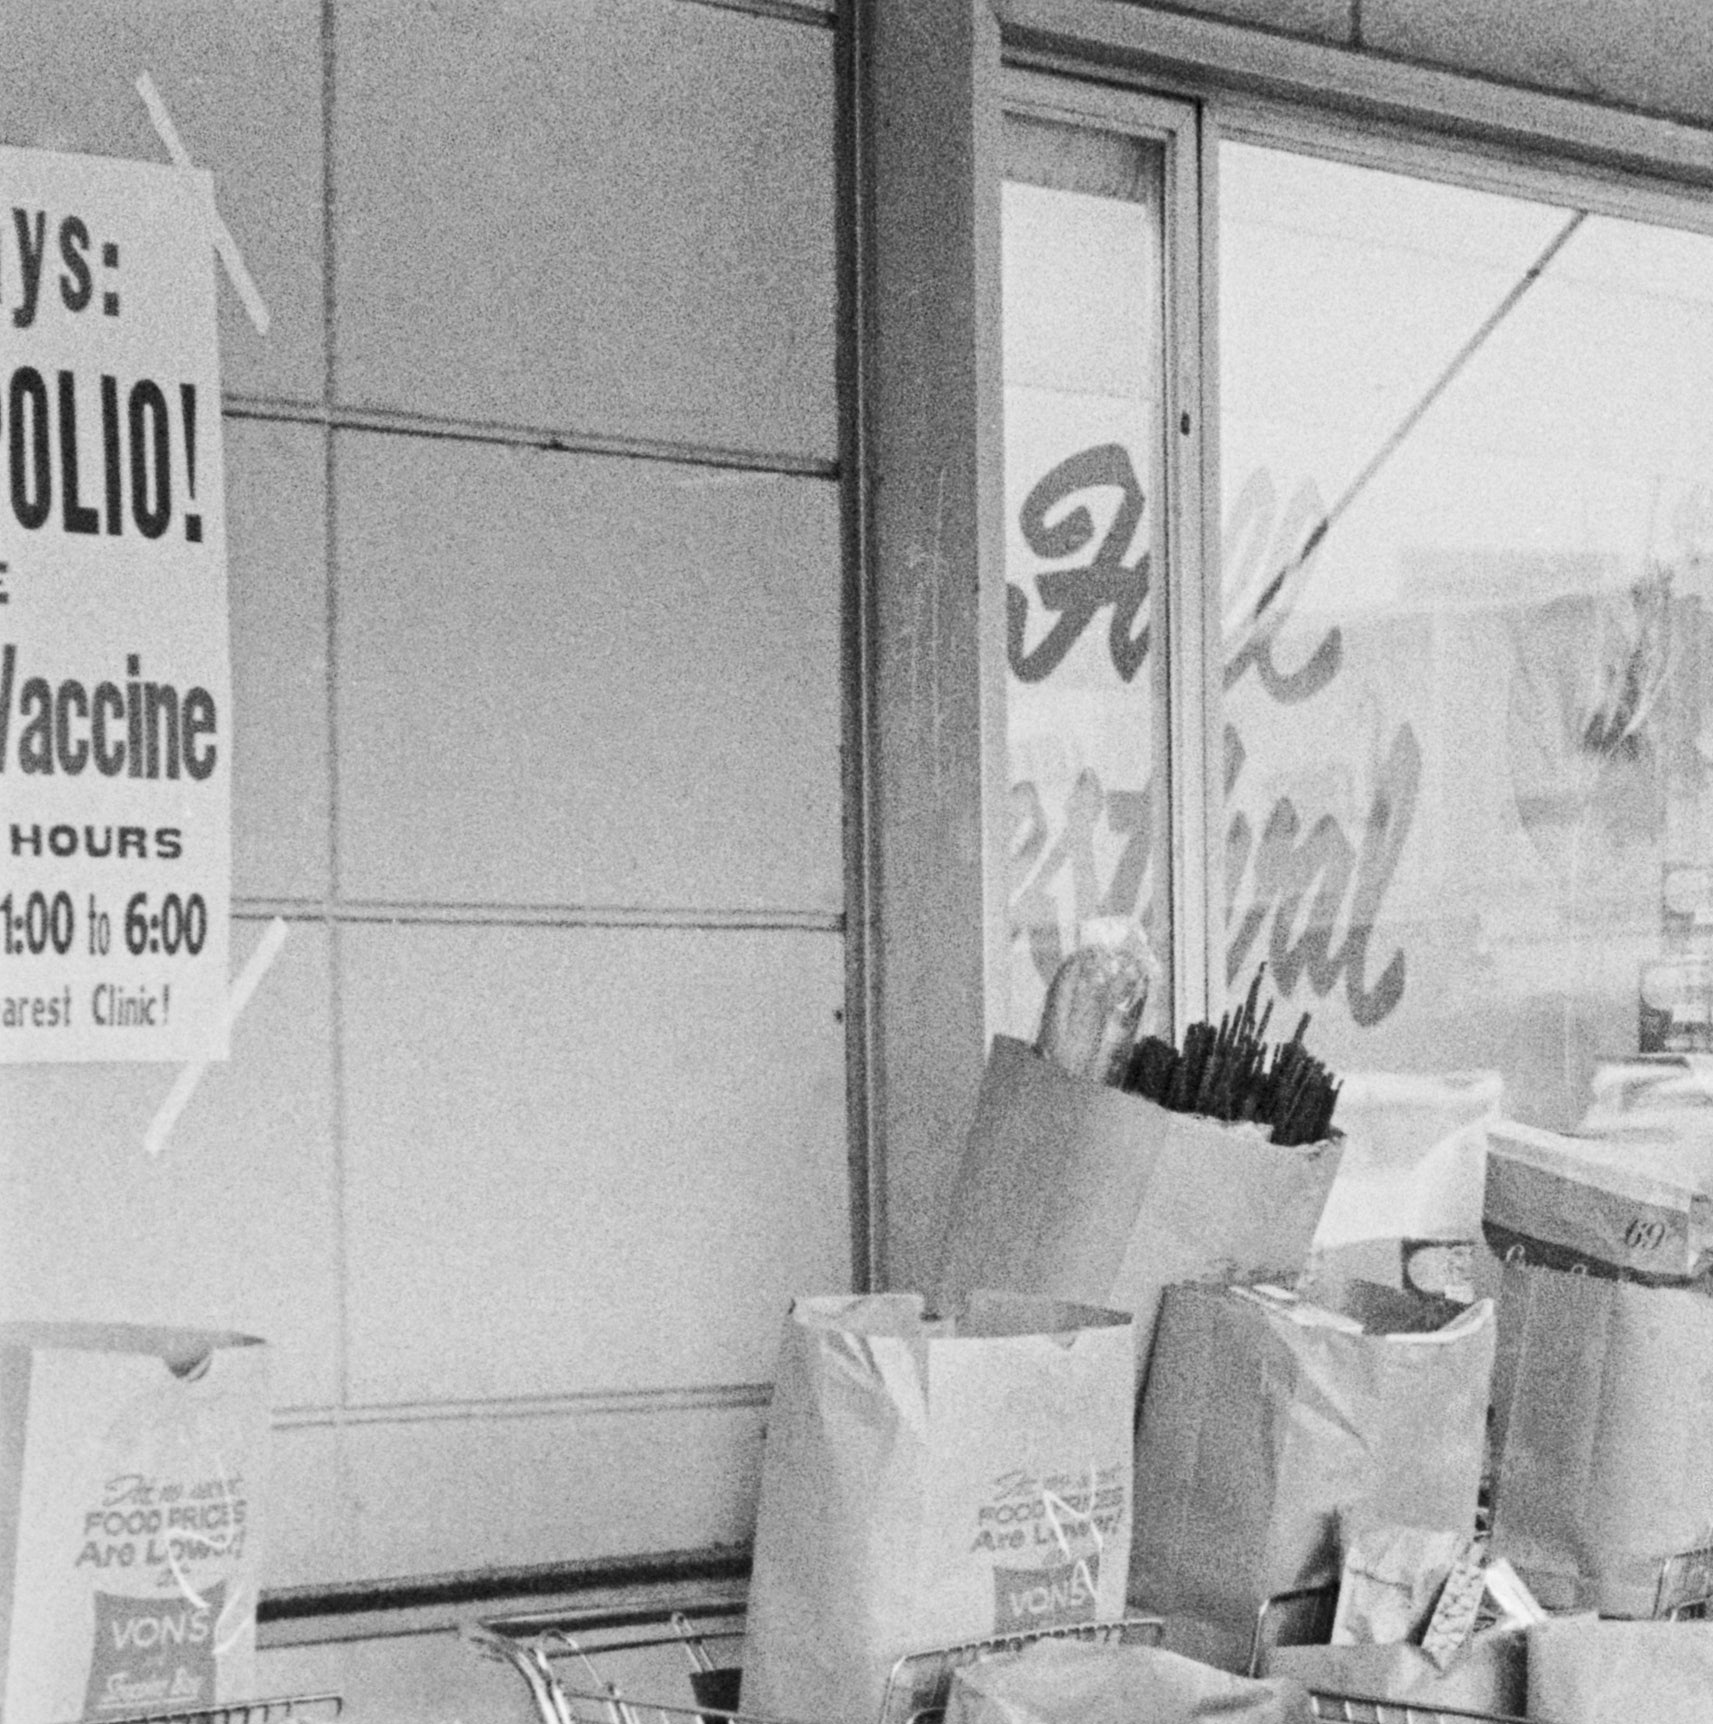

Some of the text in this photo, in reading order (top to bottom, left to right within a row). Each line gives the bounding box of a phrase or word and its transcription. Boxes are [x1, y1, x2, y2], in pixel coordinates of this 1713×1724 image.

[12, 207, 120, 328] ys:
[9, 366, 204, 544] OLIO!
[10, 824, 183, 859] HOURS
[89, 892, 112, 956] to
[124, 891, 208, 956] 6:00
[2, 983, 170, 1028] arest Clinic!
[83, 1509, 162, 1537] FOOD
[111, 1611, 209, 1650] VONS
